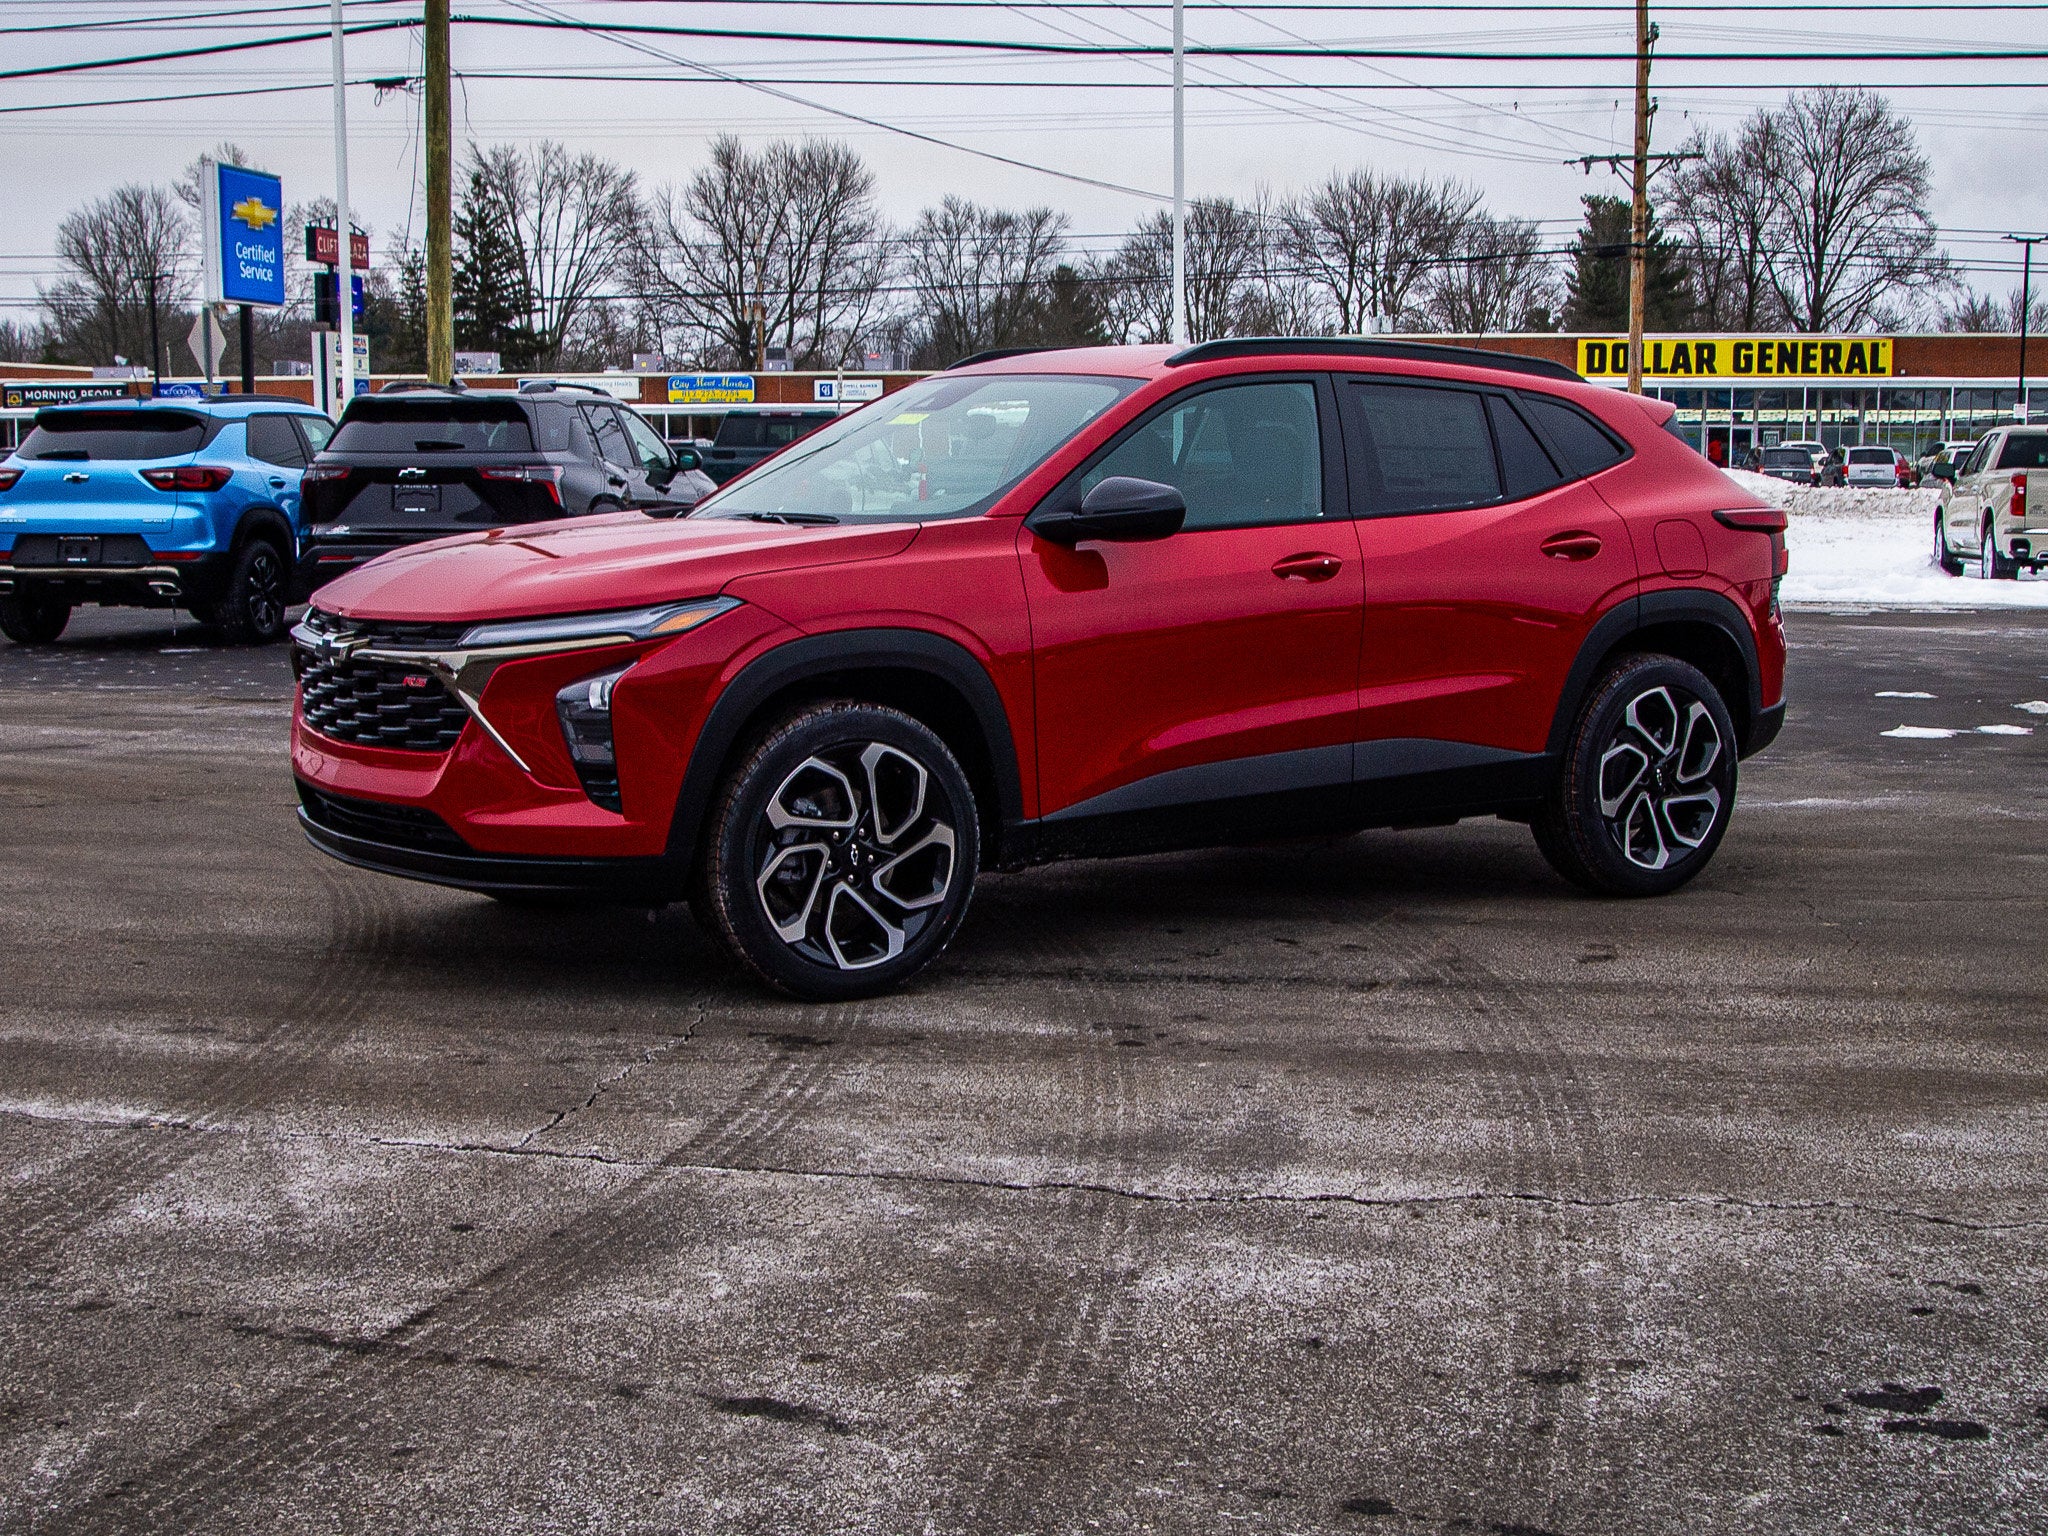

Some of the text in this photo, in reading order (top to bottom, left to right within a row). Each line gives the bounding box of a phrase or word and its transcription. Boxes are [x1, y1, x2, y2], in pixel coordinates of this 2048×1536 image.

[235, 241, 275, 263] Certified
[317, 236, 368, 260] CLIFT AZA
[240, 260, 273, 282] Service
[1732, 341, 1886, 374] GENERAL
[672, 376, 749, 389] City Meat Market
[25, 389, 77, 400] MORNING
